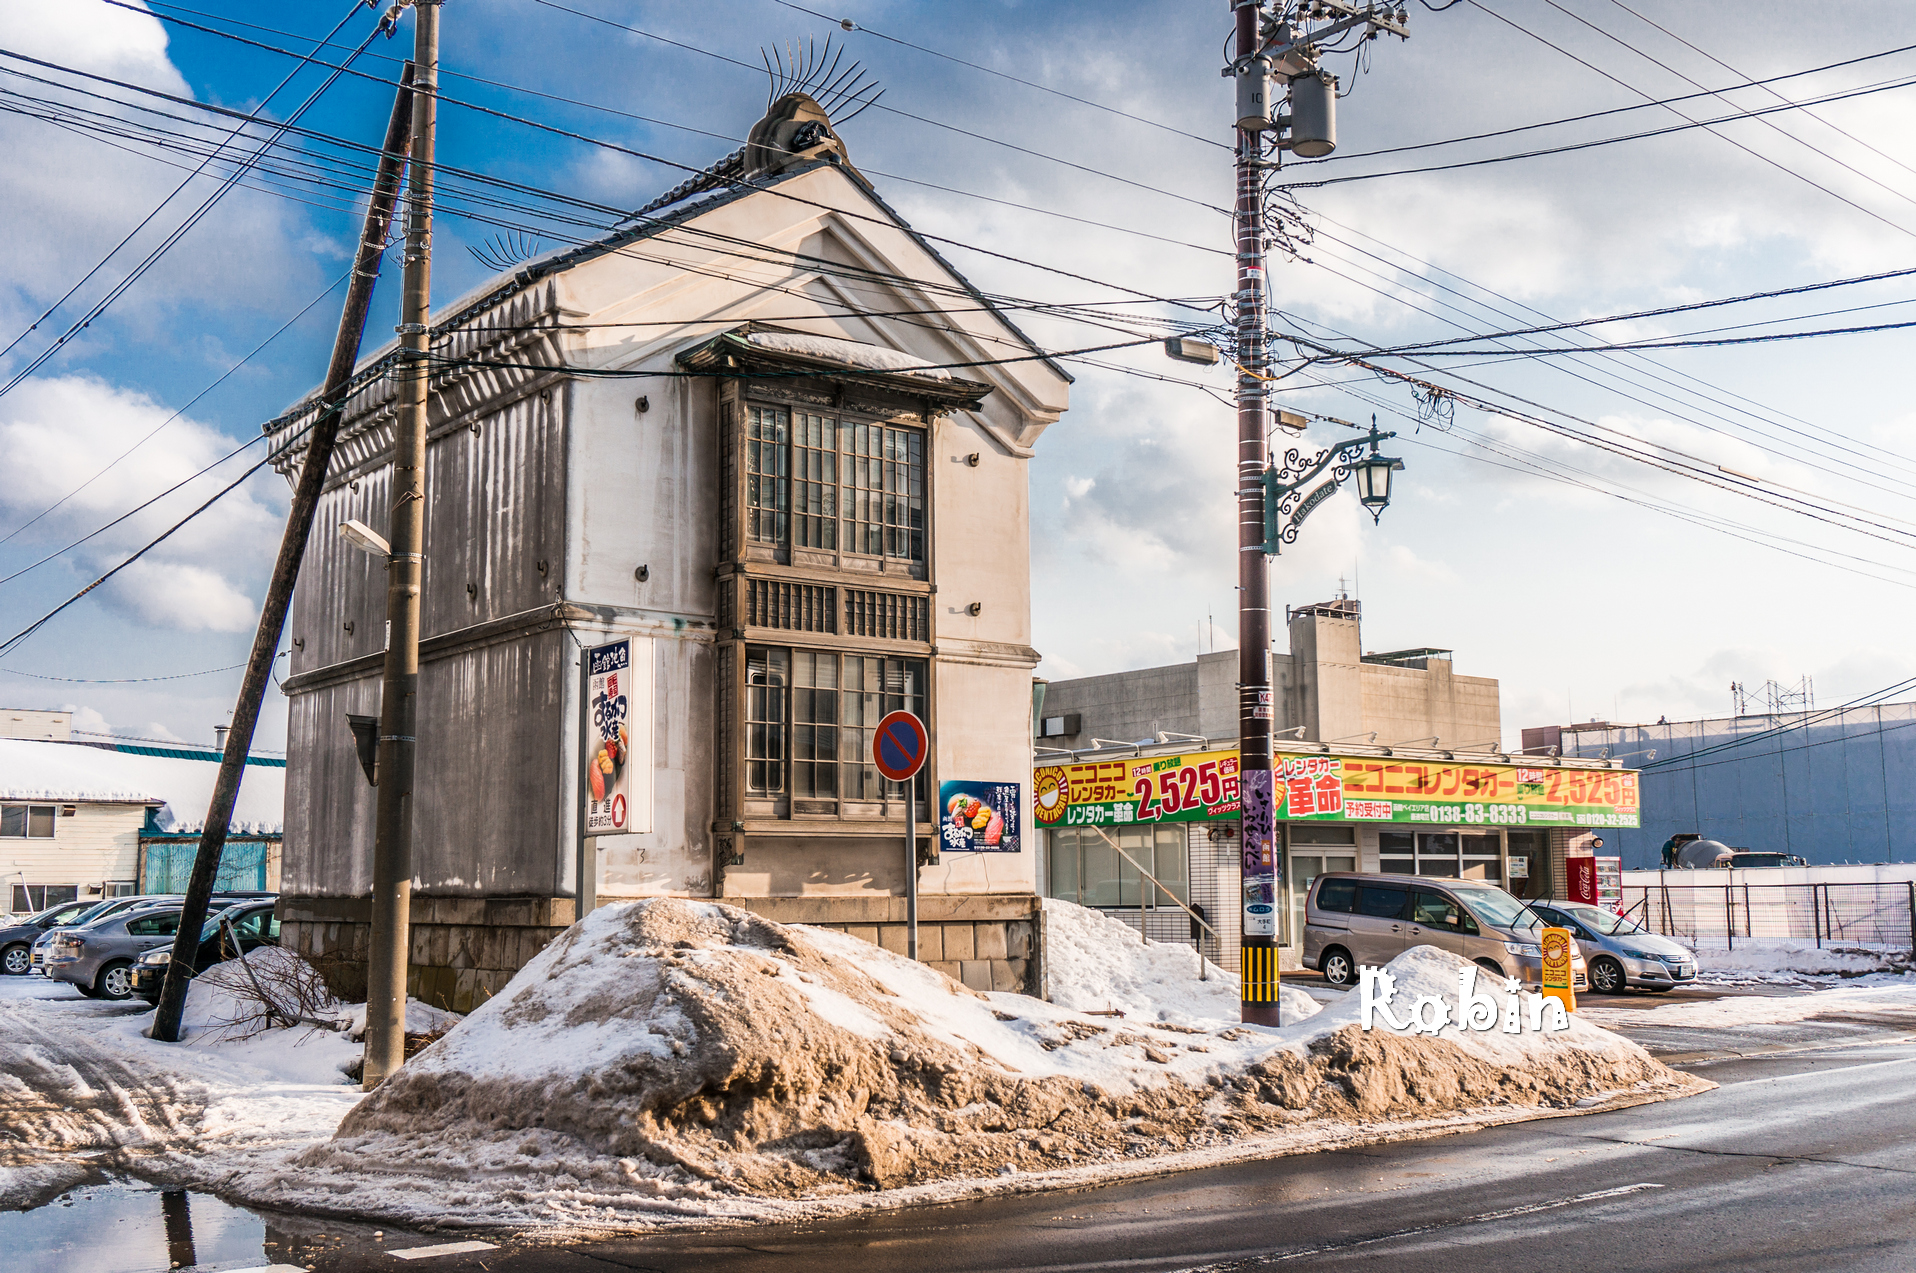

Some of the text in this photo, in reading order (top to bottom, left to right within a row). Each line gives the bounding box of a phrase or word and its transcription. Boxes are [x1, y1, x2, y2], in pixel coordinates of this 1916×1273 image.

[1294, 485, 1333, 522] Hakodate
[1071, 763, 1126, 784] ニコニコ
[1132, 757, 1181, 777] 12時間 乗り放題
[1284, 757, 1342, 776] レンタカー
[1516, 768, 1544, 783] 12時間
[1344, 763, 1515, 798] ニコニコレンタカー
[1071, 785, 1126, 803] レンタカー
[1286, 774, 1342, 816] 革命
[1067, 802, 1134, 825] レンタカー革命
[1345, 801, 1391, 818] 予約受付中
[1429, 803, 1527, 824] 0138-83-8333
[1586, 813, 1638, 826] 0120-32-2525
[1544, 969, 1567, 977] ニコニコ
